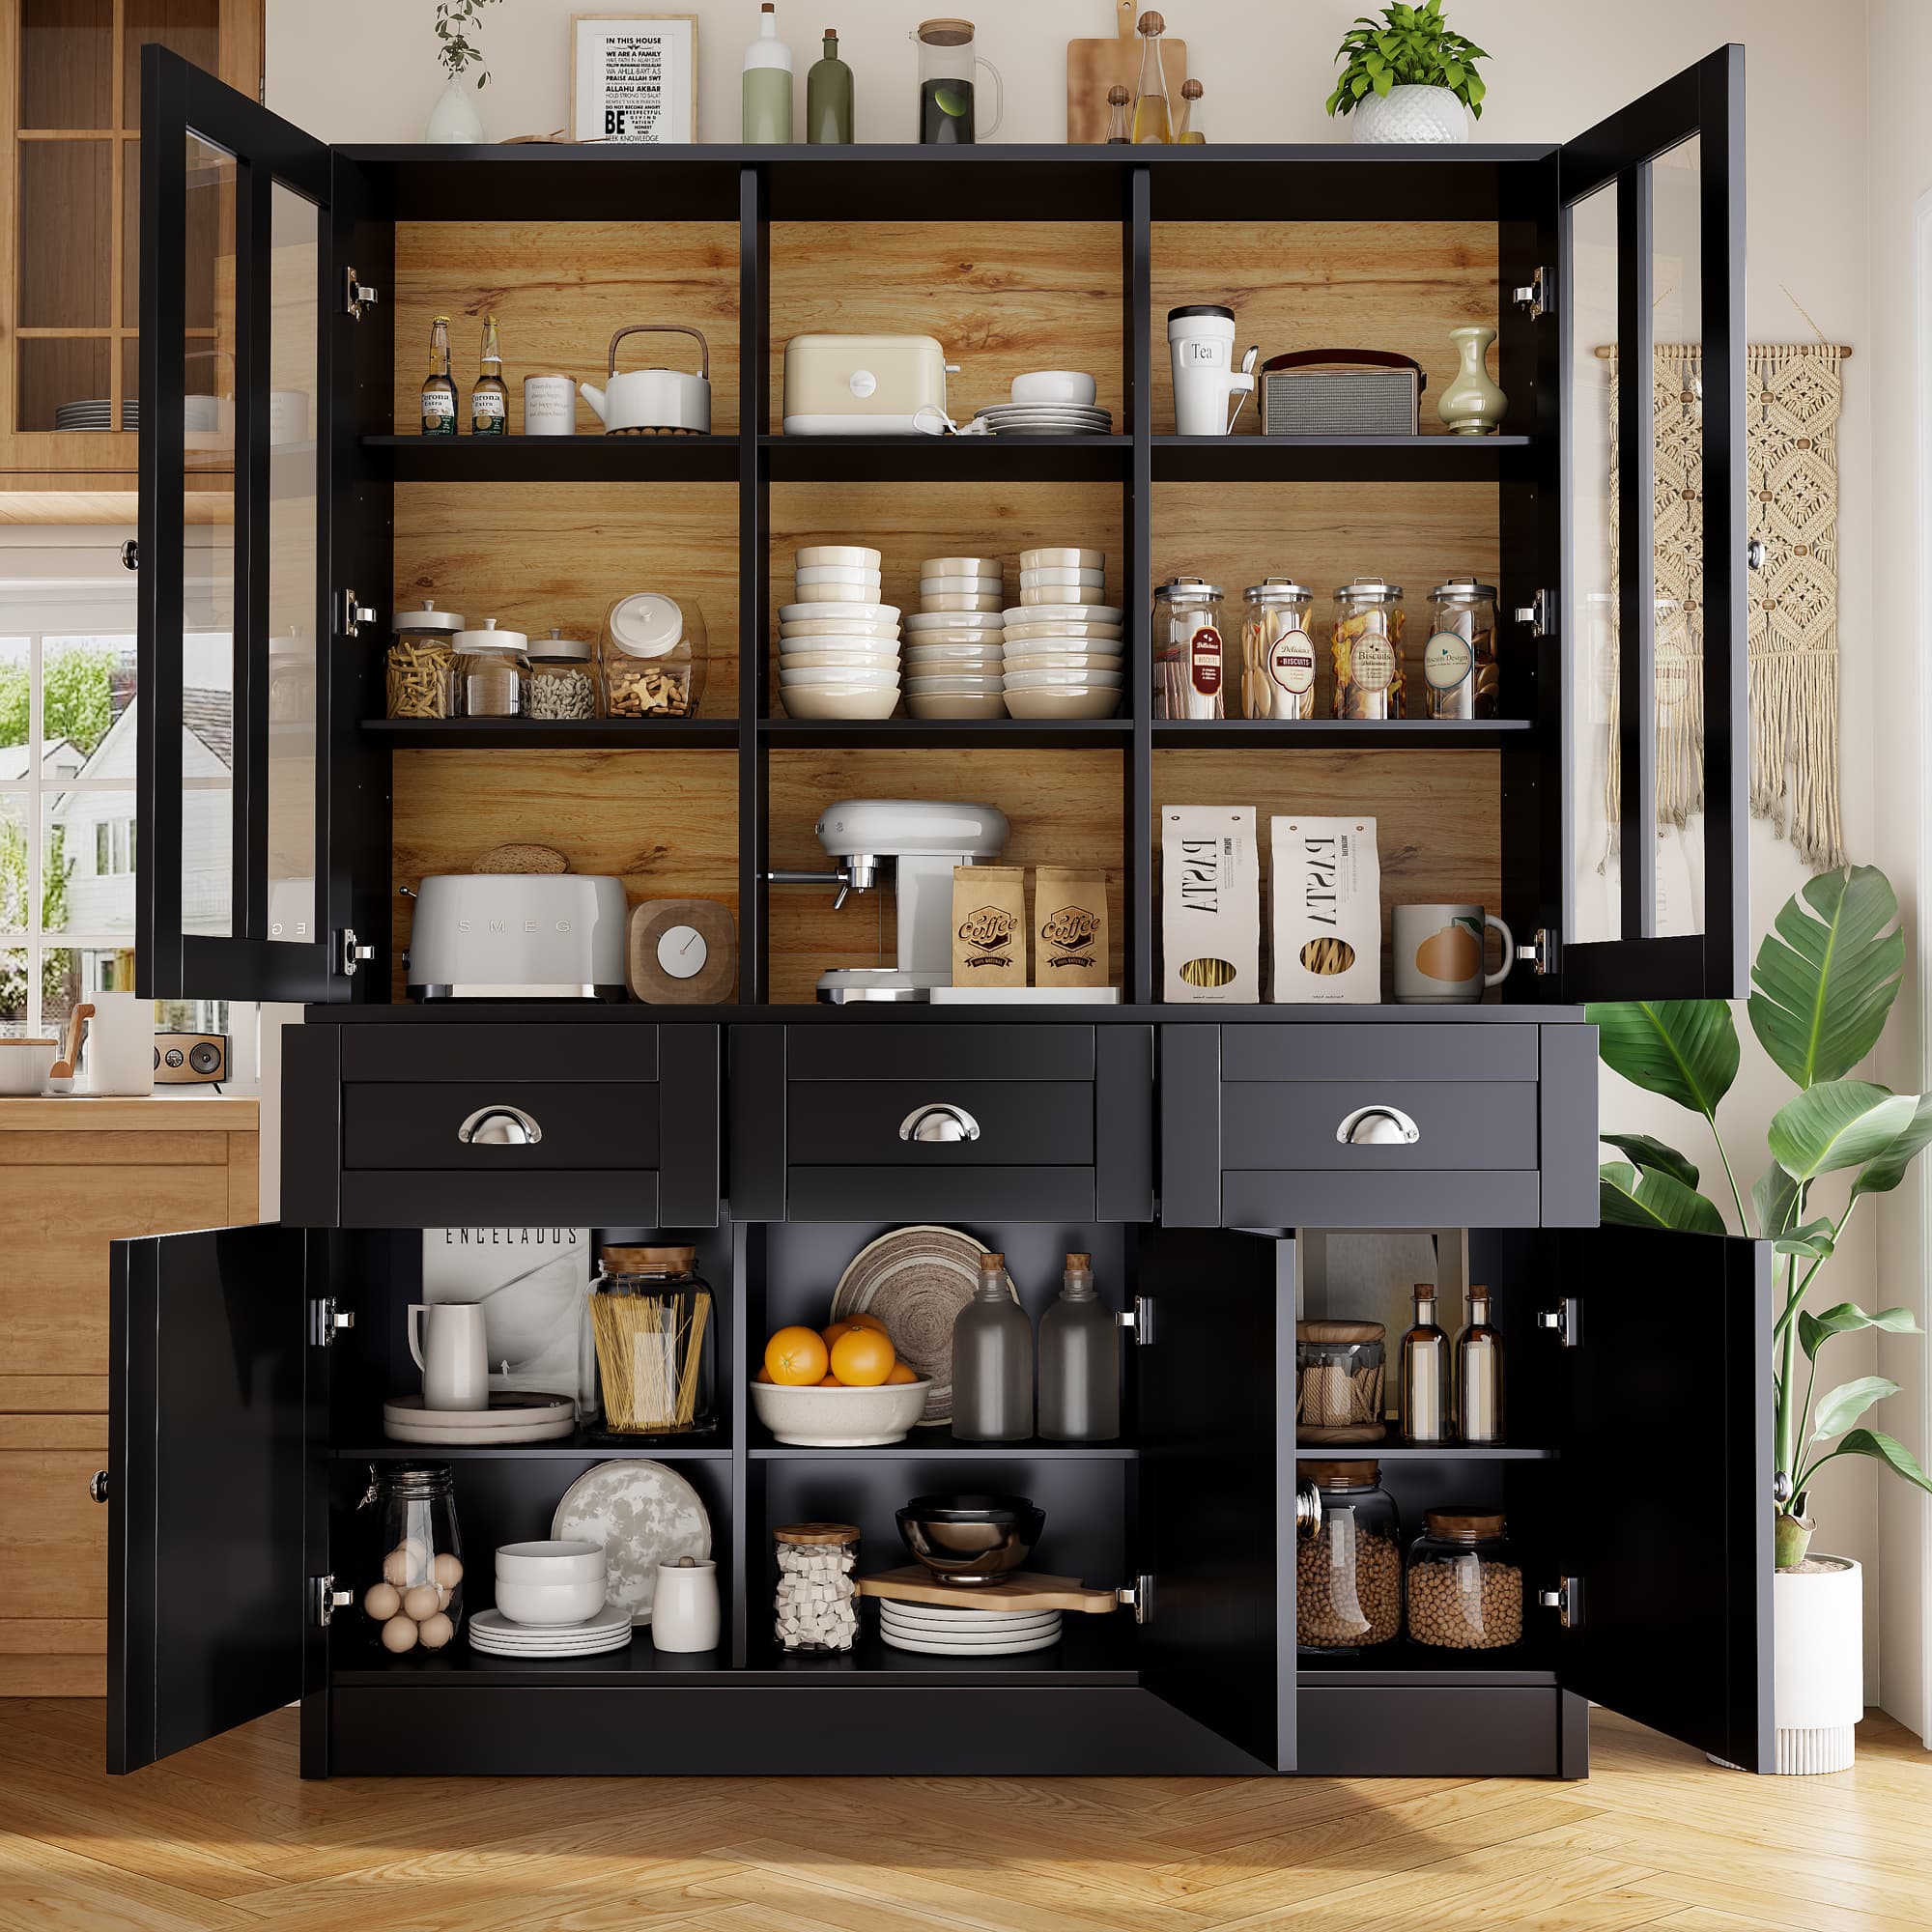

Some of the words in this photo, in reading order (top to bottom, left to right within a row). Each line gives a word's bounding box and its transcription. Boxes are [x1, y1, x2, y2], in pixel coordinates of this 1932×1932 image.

[606, 110, 625, 134] BE
[1192, 343, 1212, 358] Tea
[1358, 651, 1391, 660] Biscuits
[458, 920, 570, 933] SMEG
[958, 915, 1017, 939] Coffee
[1041, 915, 1100, 939] Coffee
[446, 1229, 576, 1244] ENCELADOS
